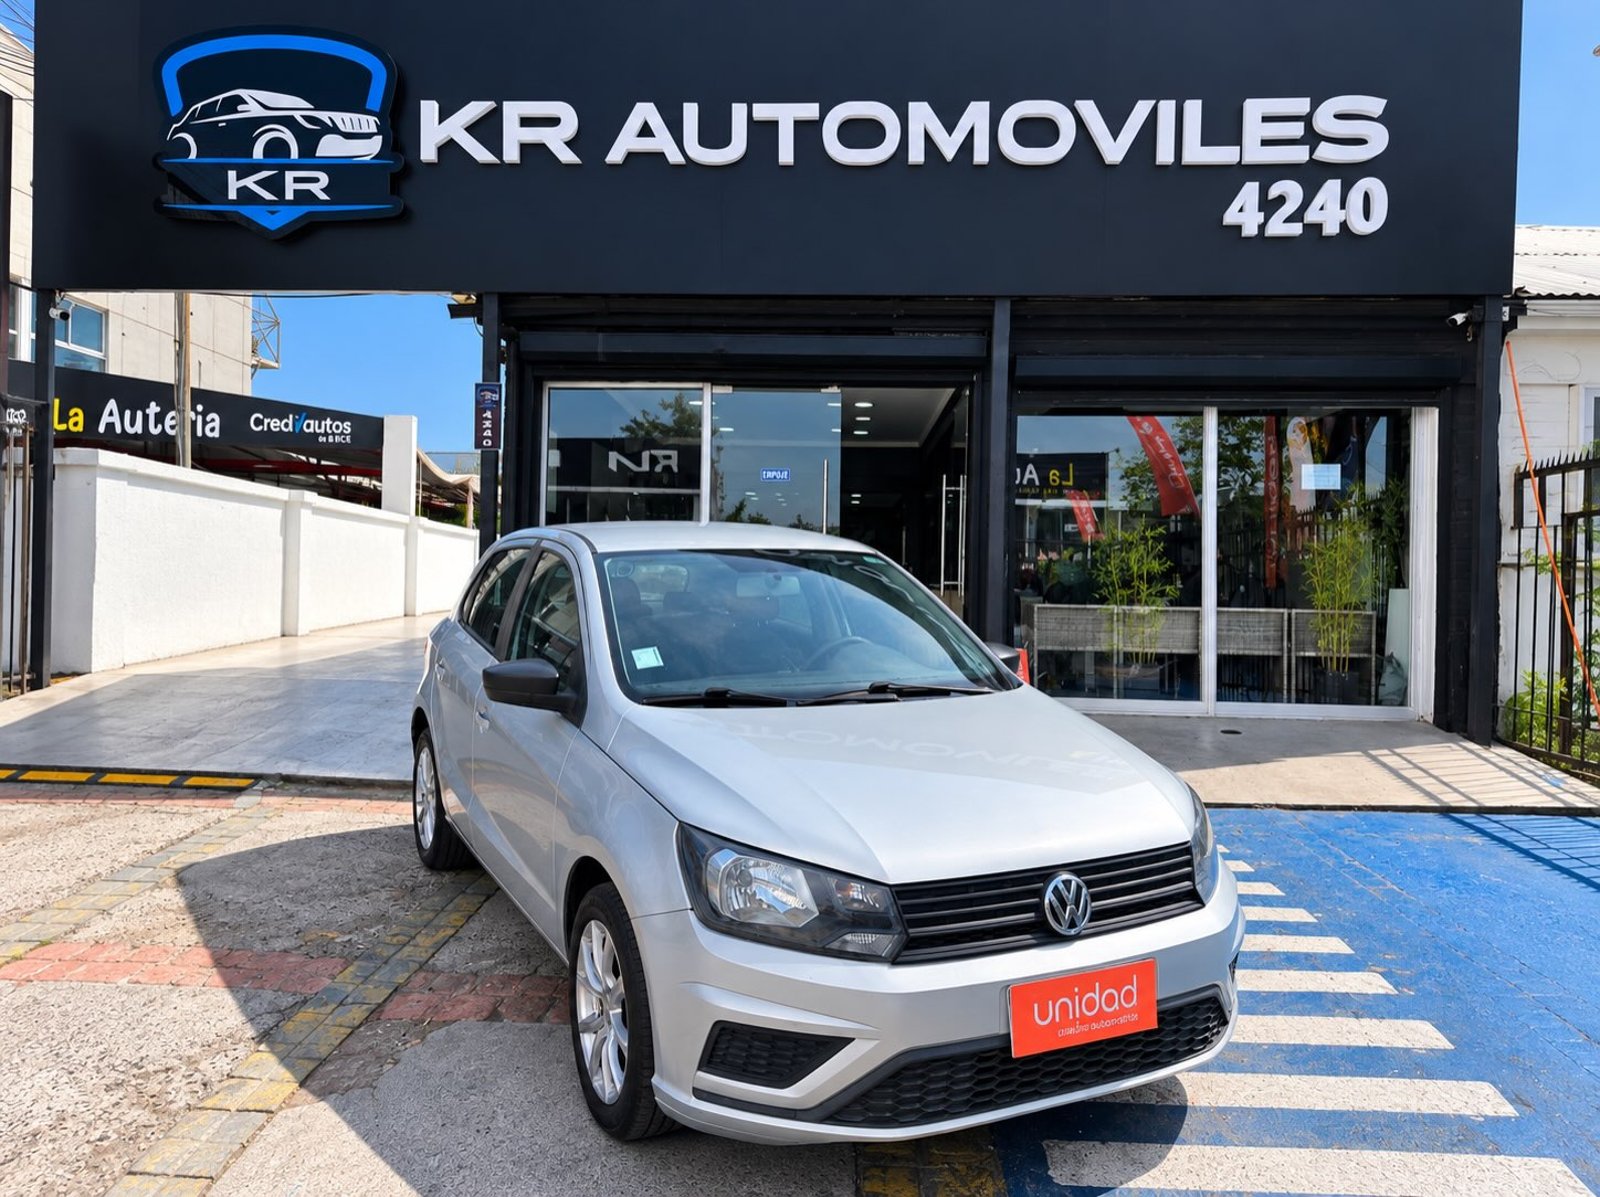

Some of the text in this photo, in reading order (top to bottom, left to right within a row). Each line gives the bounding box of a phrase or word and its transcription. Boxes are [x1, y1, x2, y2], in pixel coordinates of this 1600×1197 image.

[420, 94, 1389, 166] KR AUTOMOVILES
[227, 169, 331, 201] KR
[1222, 176, 1389, 238] 4240
[1033, 973, 1138, 1027] unidad
